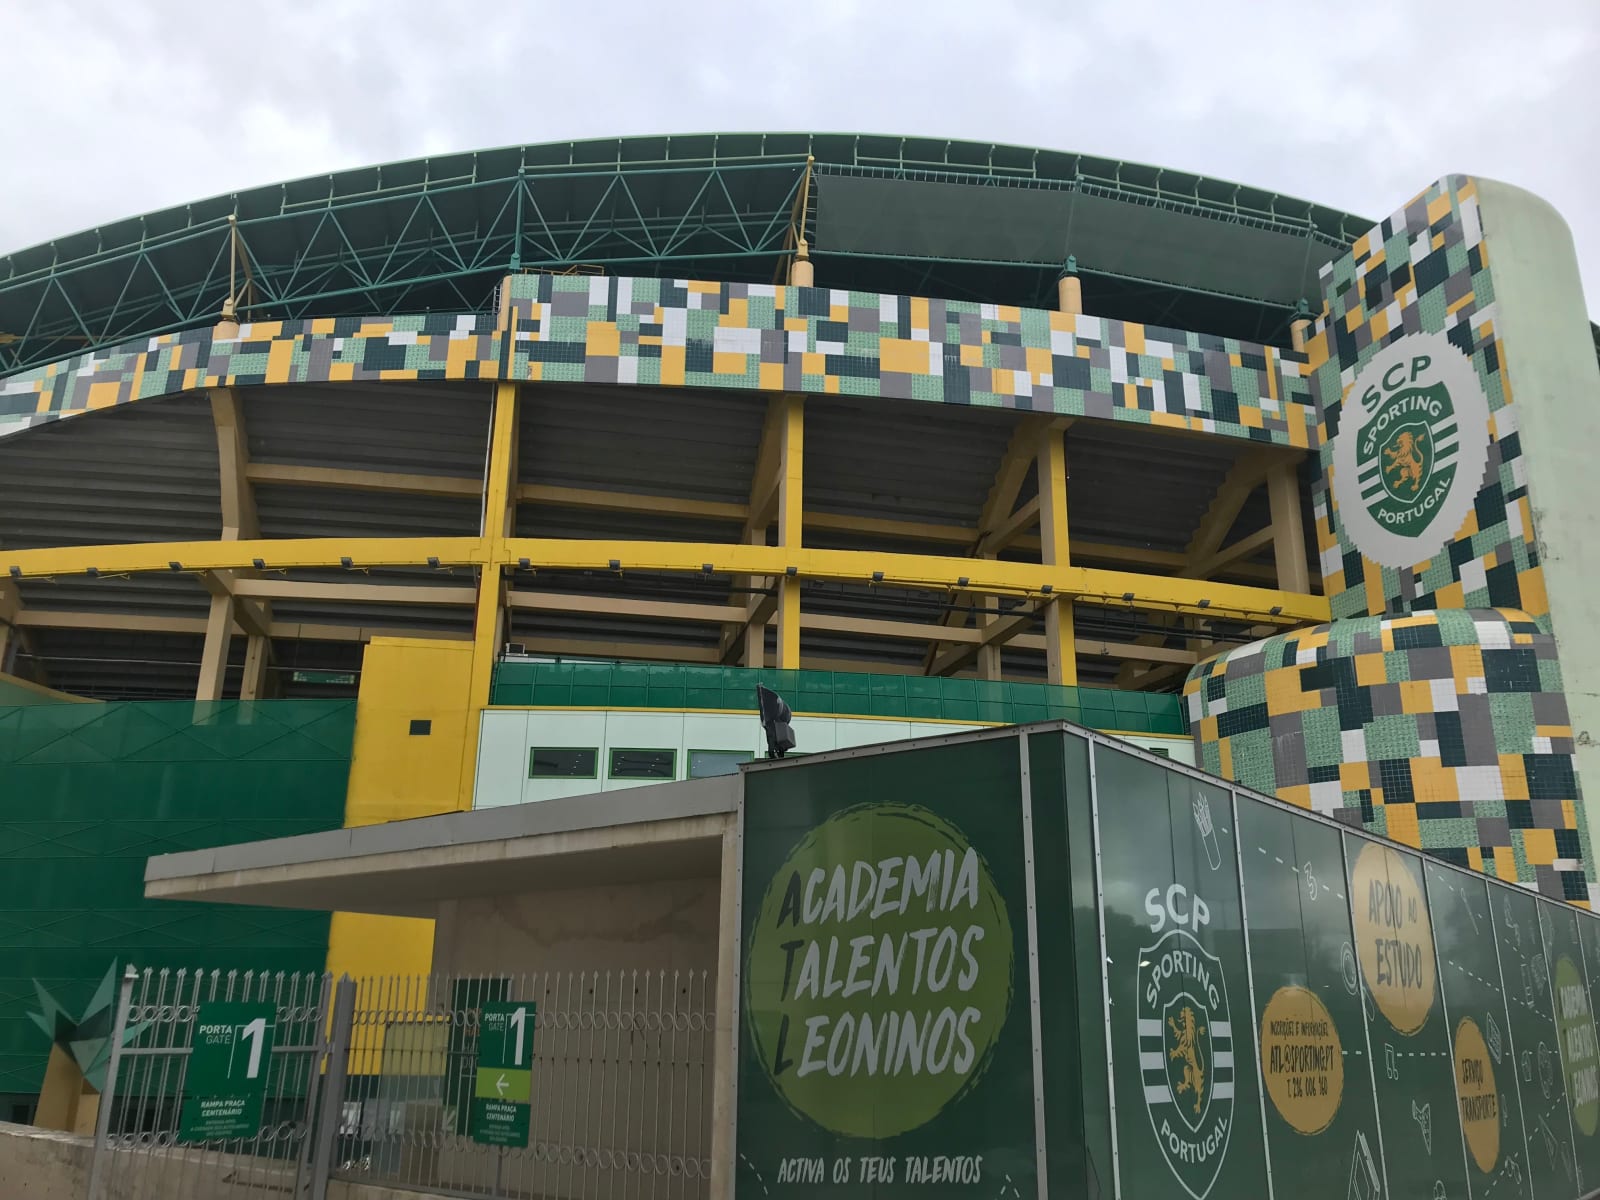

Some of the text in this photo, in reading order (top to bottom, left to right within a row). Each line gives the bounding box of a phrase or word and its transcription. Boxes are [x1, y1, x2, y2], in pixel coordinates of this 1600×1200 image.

[1361, 355, 1431, 414] SCP
[1363, 395, 1442, 455] SPORTING
[1377, 477, 1451, 524] PORTUGAL
[776, 846, 979, 929] ACADEMIA
[1145, 883, 1210, 933] SCP
[1368, 879, 1403, 929] APOIO
[780, 924, 985, 1002] TALENTOS
[1146, 950, 1220, 1010] SPORTING
[1375, 938, 1422, 989] ESTUDO
[199, 1018, 266, 1079] PORTA 1
[205, 1035, 231, 1044] GATE
[485, 1013, 504, 1022] PORTA
[510, 1007, 526, 1066] 1
[488, 1022, 504, 1031] GATE
[773, 1006, 981, 1078] LEONINOS
[201, 1108, 242, 1117] CENTENÁRIO
[224, 1100, 245, 1108] PRAÇA
[1161, 1117, 1227, 1163] PORTUGAL
[777, 1155, 983, 1184] ACTIVA OS TEUS TALENTOS
